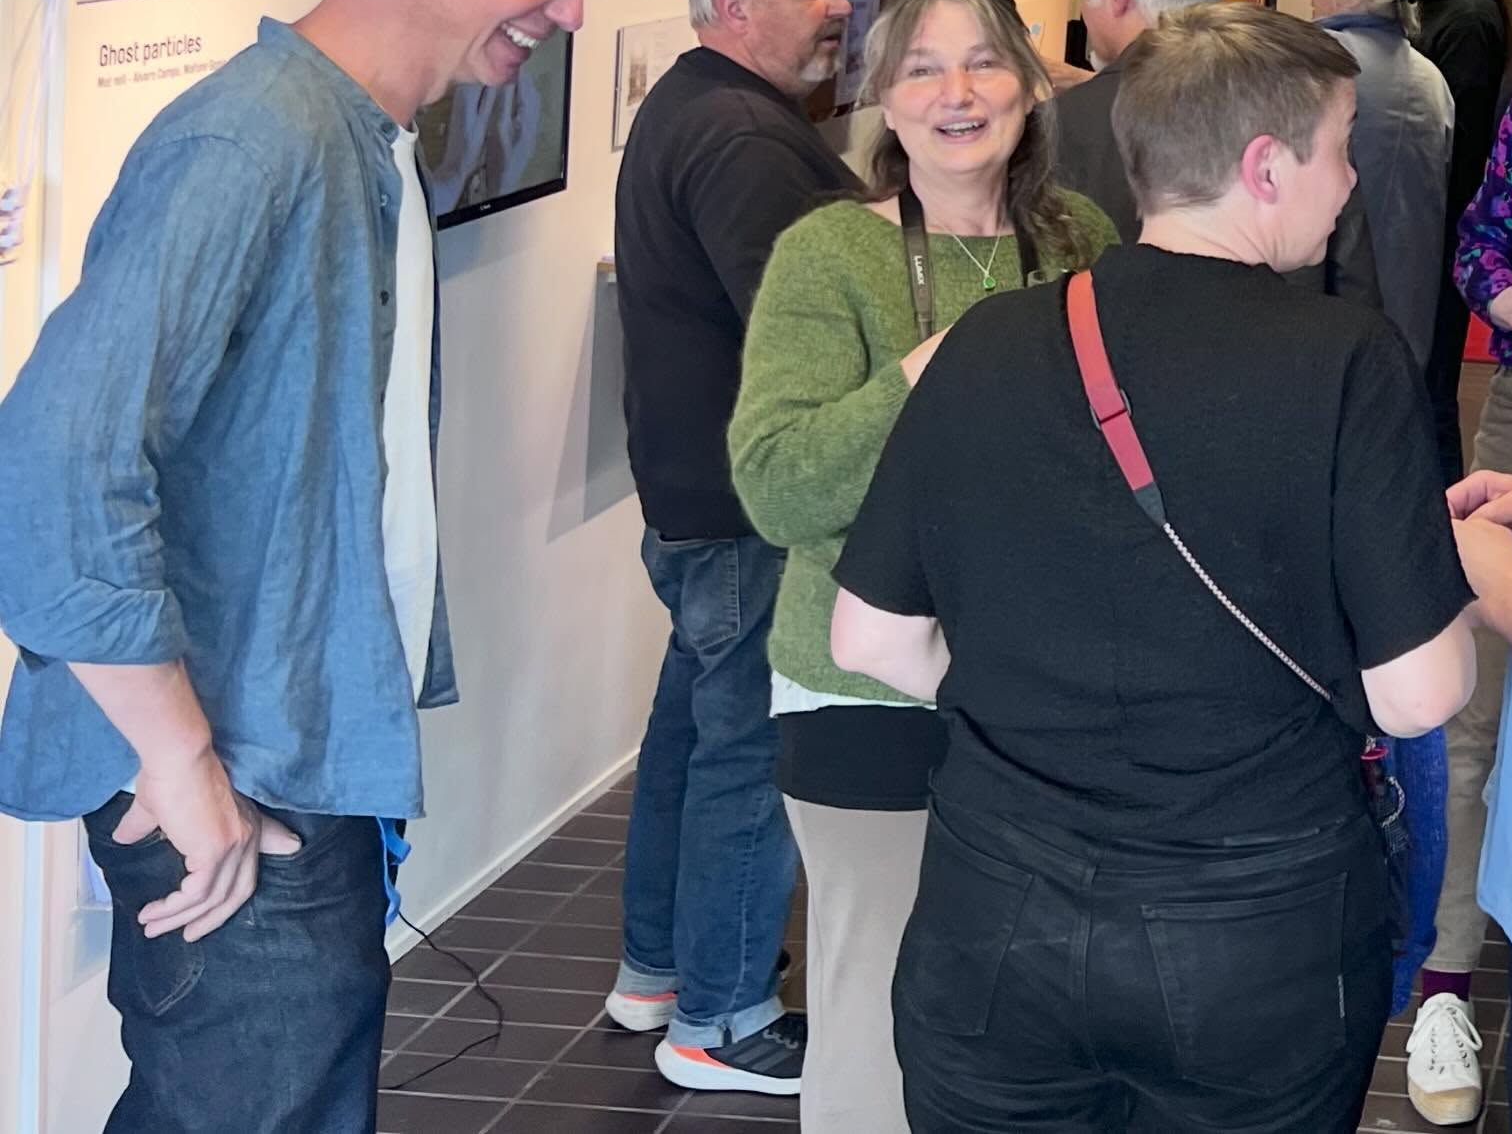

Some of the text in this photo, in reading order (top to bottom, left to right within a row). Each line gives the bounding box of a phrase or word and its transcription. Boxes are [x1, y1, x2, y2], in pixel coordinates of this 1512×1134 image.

[100, 42, 139, 67] Ghost
[143, 35, 202, 65] particles
[914, 255, 925, 285] LUMIX
